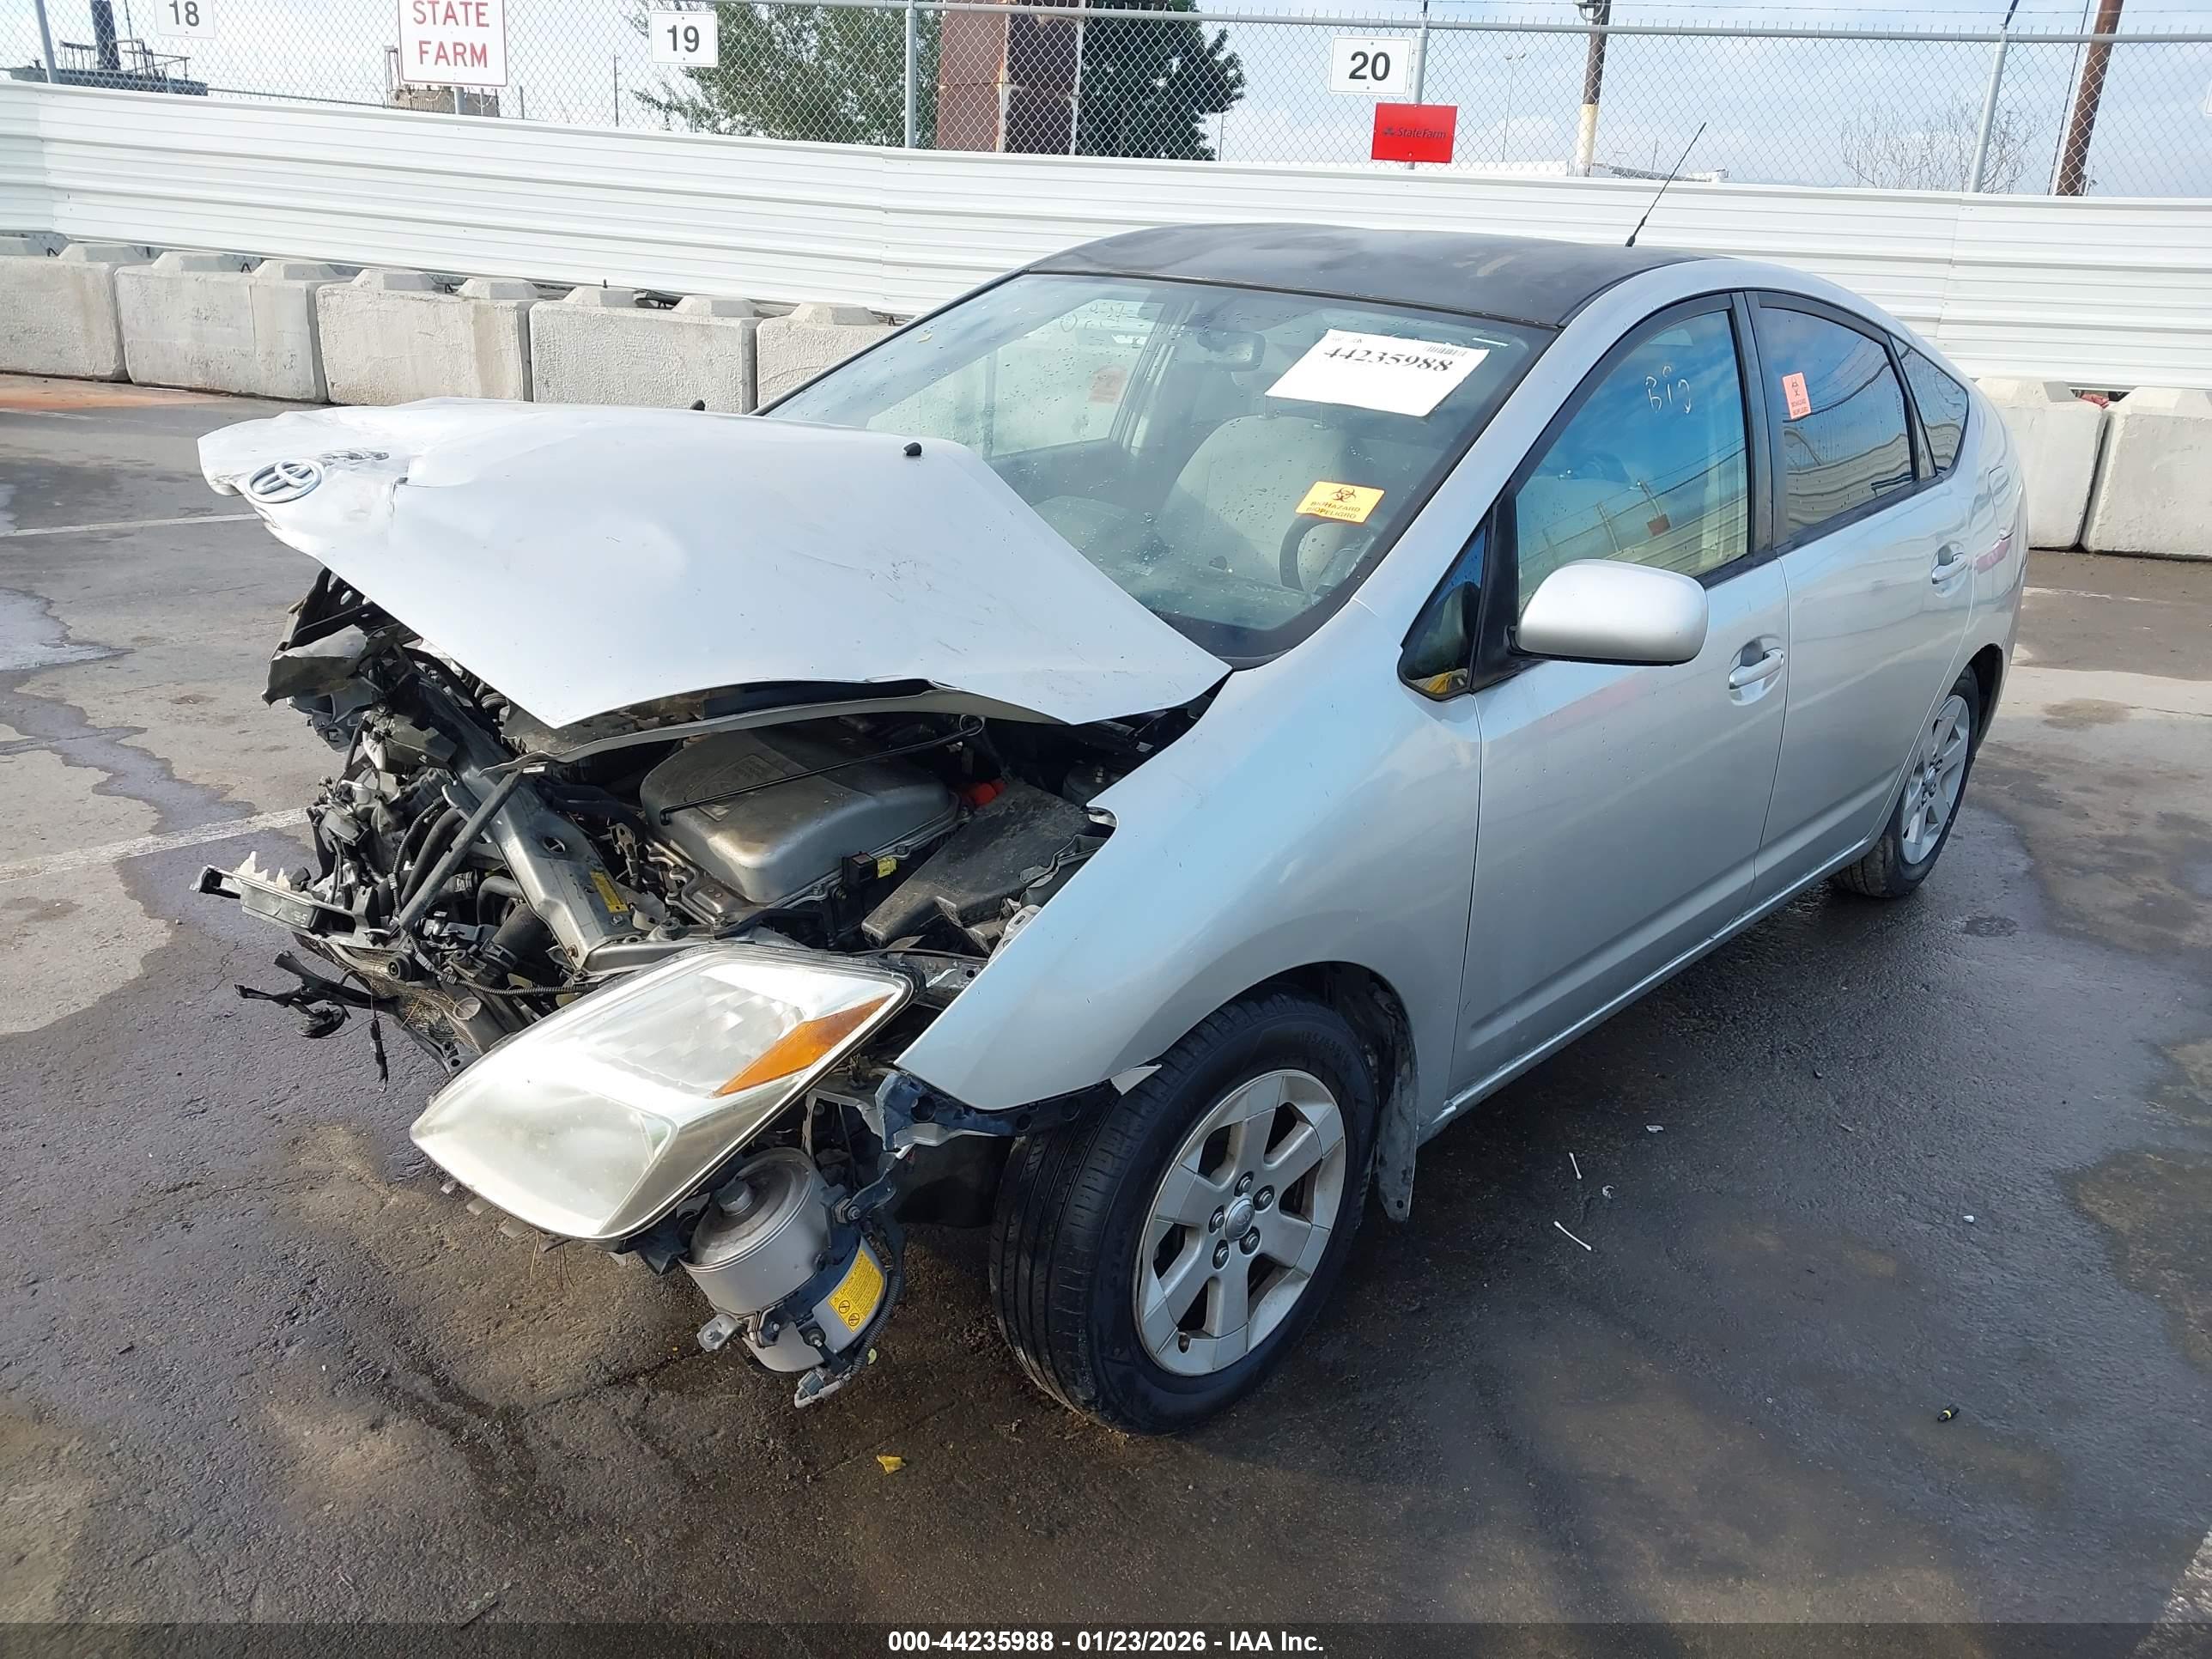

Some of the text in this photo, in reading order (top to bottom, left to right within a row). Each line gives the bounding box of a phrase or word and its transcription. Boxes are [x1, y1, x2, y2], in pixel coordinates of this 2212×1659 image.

[168, 0, 200, 27] 18
[413, 0, 489, 27] STATE
[667, 24, 700, 52] 19
[418, 40, 488, 68] FARM
[1348, 51, 1390, 81] 20
[1323, 347, 1454, 372] 44235988
